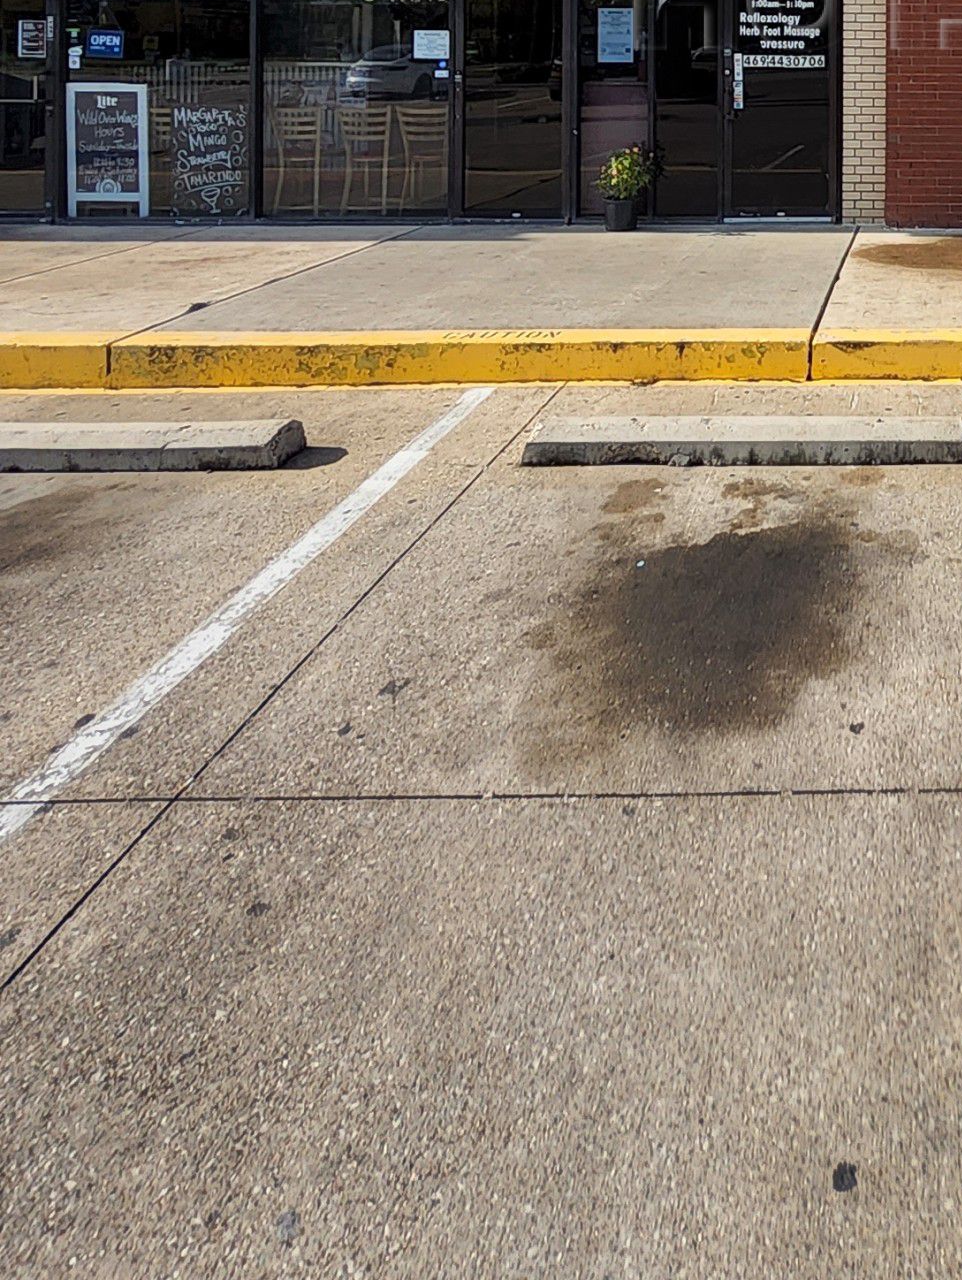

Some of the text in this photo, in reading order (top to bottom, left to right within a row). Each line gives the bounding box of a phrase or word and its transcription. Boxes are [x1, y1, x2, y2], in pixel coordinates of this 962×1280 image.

[740, 12, 800, 26] Reflexology
[740, 25, 820, 38] Herb Foot Massage
[91, 34, 120, 46] OPEN
[96, 95, 118, 108] Lite
